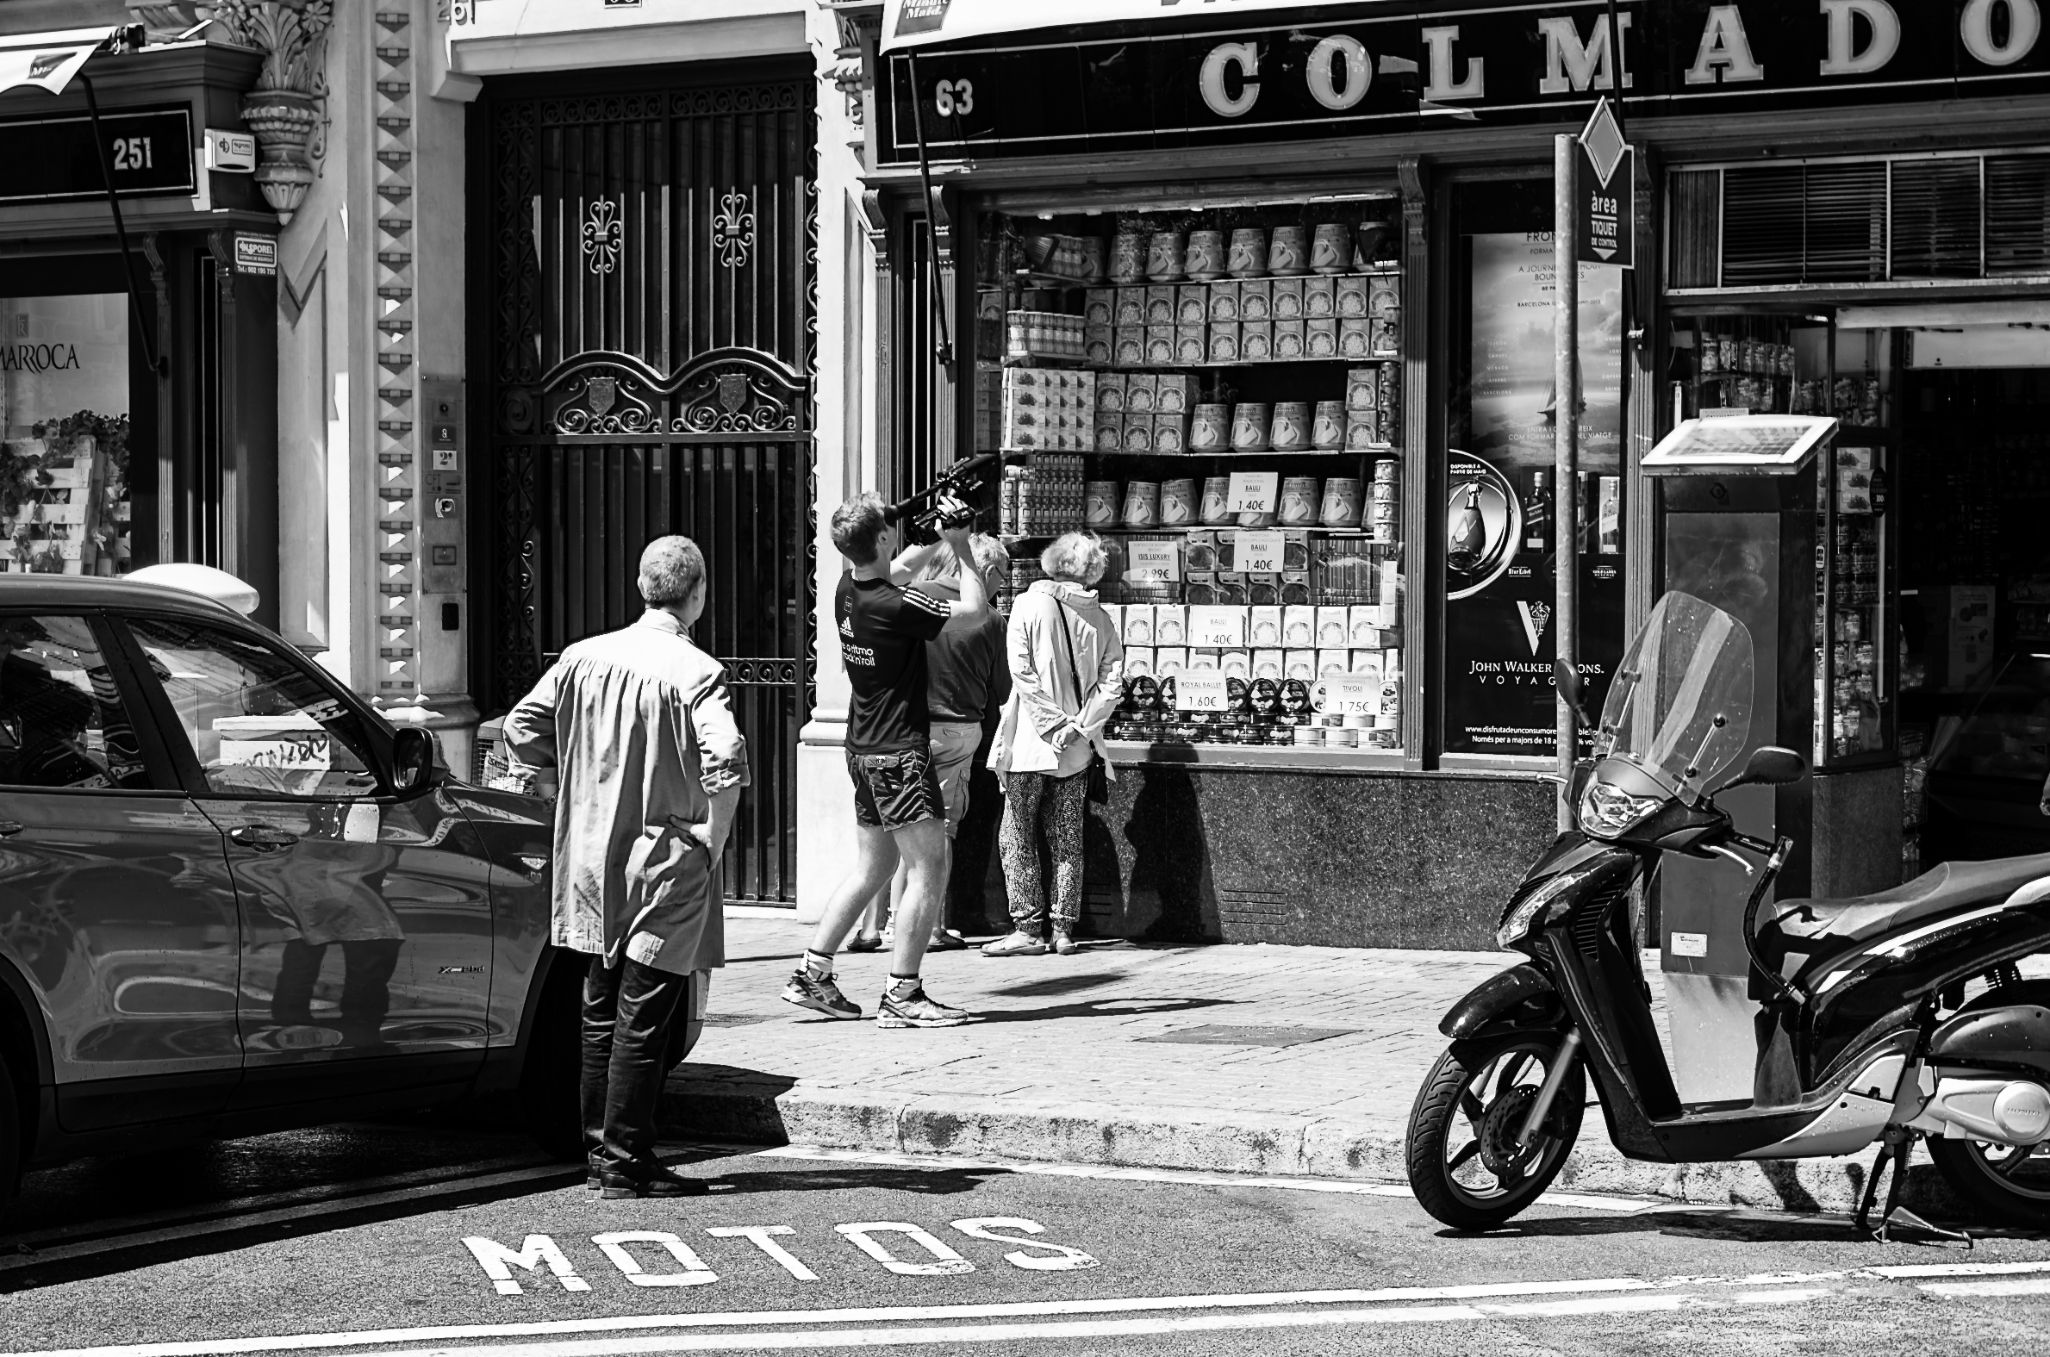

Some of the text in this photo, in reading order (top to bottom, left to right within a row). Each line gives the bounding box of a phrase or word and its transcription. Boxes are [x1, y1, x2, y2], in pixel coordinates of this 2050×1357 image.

[1200, 0, 2041, 118] COLMADO
[935, 78, 974, 117] 63
[112, 136, 153, 170] 251
[1591, 190, 1617, 214] àrea
[1591, 220, 1618, 237] TIQUET
[1599, 238, 1618, 249] CONTROL
[1479, 675, 1590, 686] VOYAGR
[461, 1215, 1101, 1295] MOTOS
